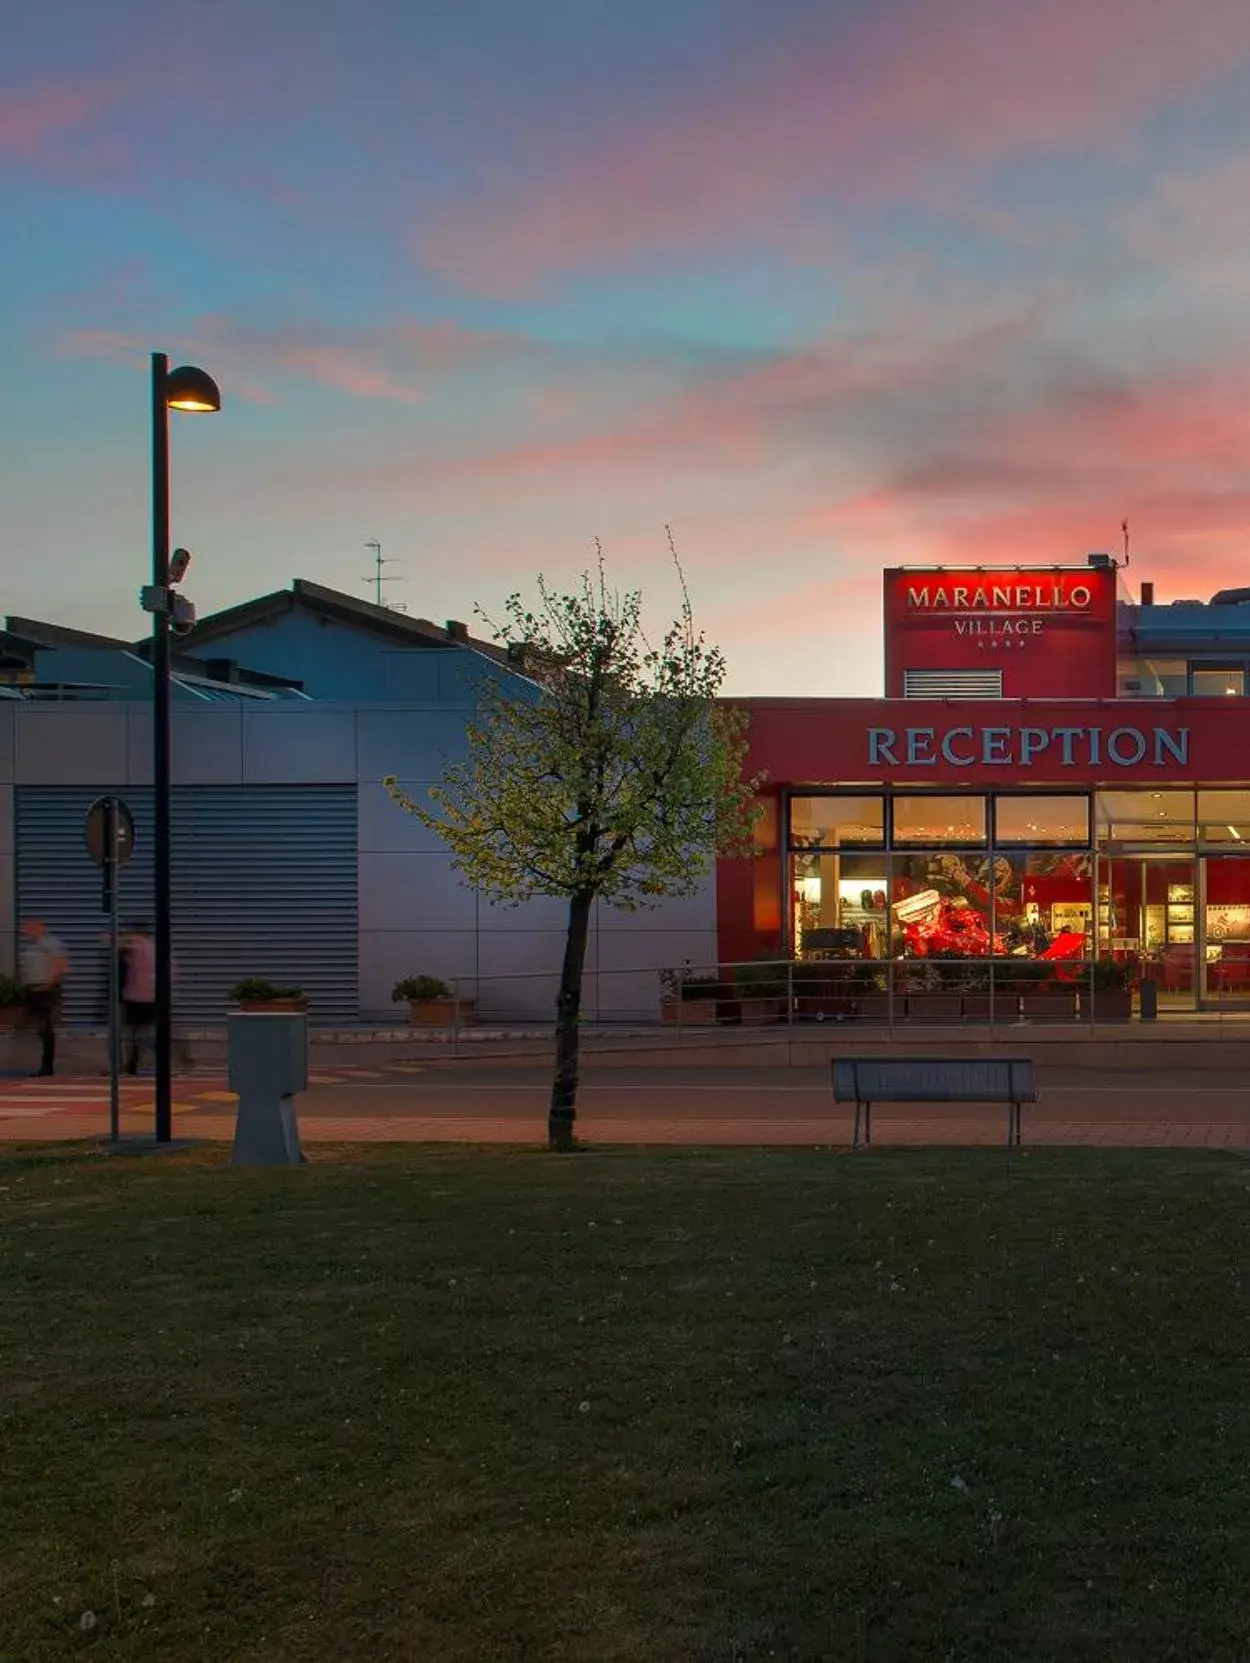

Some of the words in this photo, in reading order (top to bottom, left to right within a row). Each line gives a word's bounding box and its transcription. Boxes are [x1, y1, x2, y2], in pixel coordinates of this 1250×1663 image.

[908, 586, 1091, 608] MARANELLO
[954, 620, 1044, 634] VILLAGE
[866, 727, 1190, 766] RECEPTION
